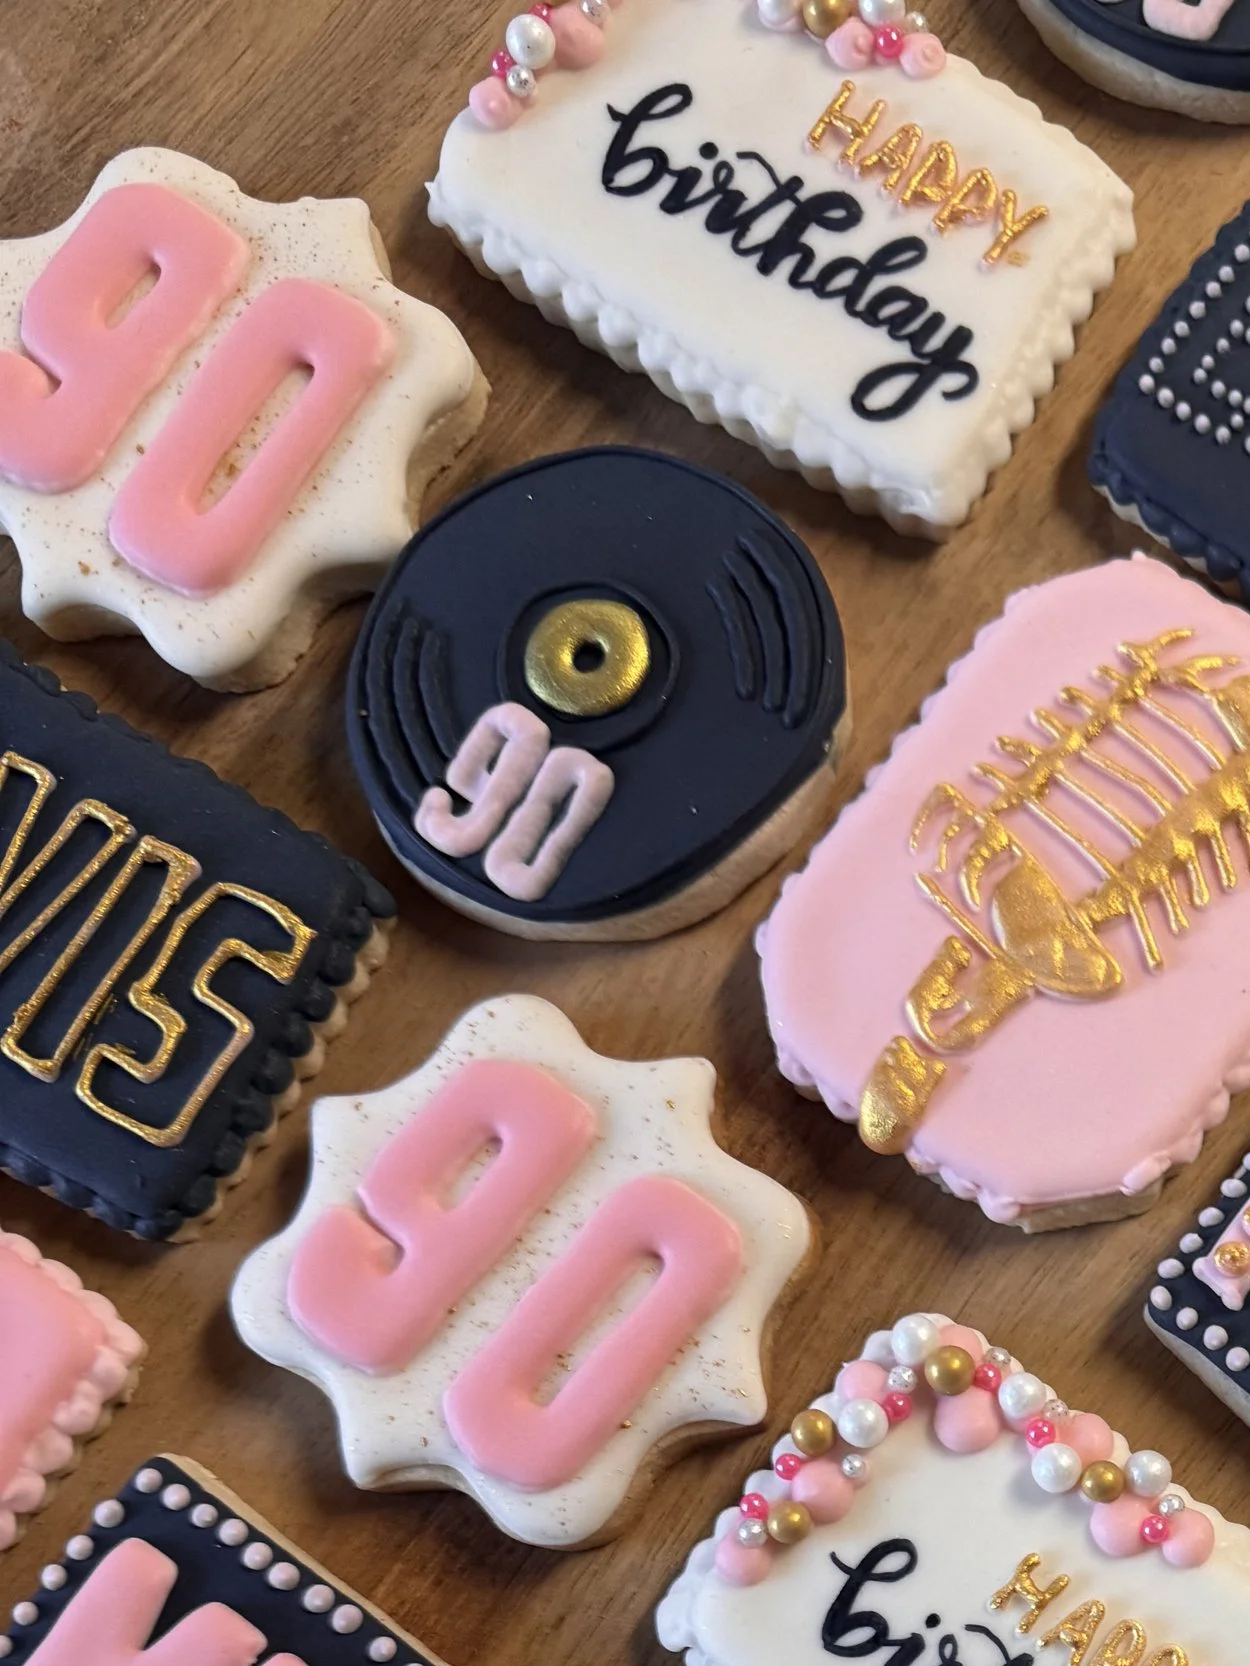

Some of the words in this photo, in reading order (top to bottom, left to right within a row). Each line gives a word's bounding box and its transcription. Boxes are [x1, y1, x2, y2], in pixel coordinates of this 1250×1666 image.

[602, 82, 979, 421] birthday
[804, 79, 1049, 269] HAPPY
[0, 182, 395, 598] 90
[414, 701, 614, 901] 90
[288, 1060, 743, 1492] 90
